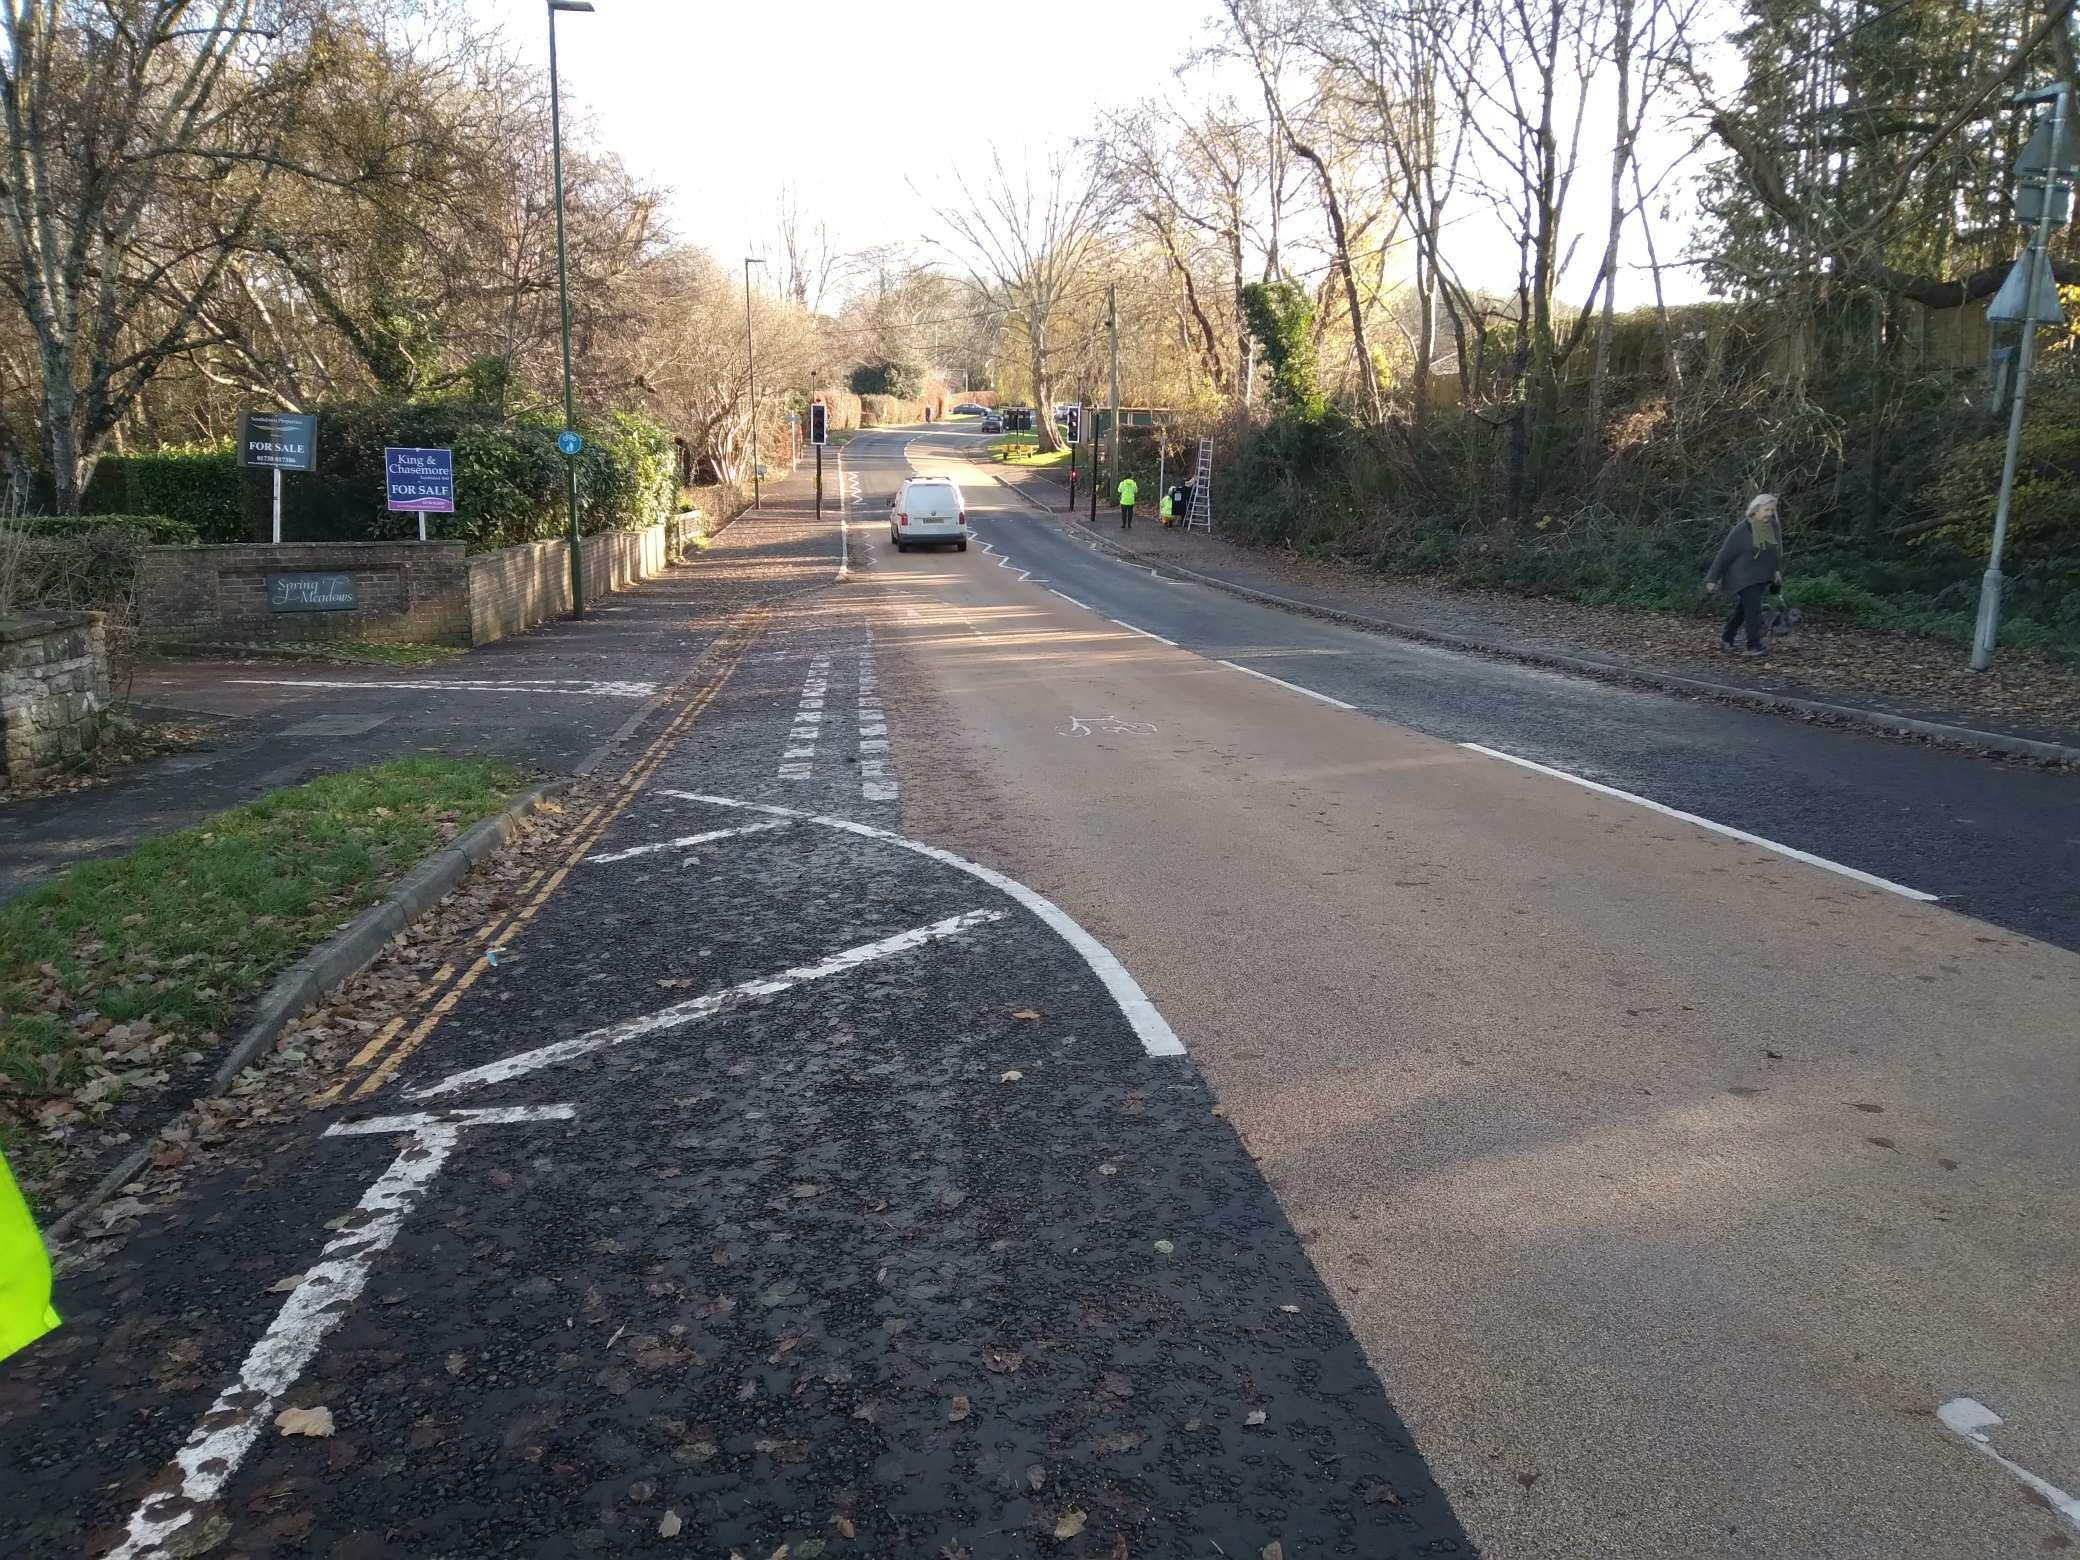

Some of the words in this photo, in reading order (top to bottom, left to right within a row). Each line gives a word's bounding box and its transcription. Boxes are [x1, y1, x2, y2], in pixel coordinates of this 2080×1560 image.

[249, 441, 272, 451] FOR
[275, 442, 305, 454] SALE
[398, 454, 424, 467] King
[426, 455, 436, 465] &
[389, 463, 449, 475] Chasemore
[392, 484, 416, 495] FOR
[273, 578, 318, 604] Spring
[300, 580, 353, 604] Meadows
